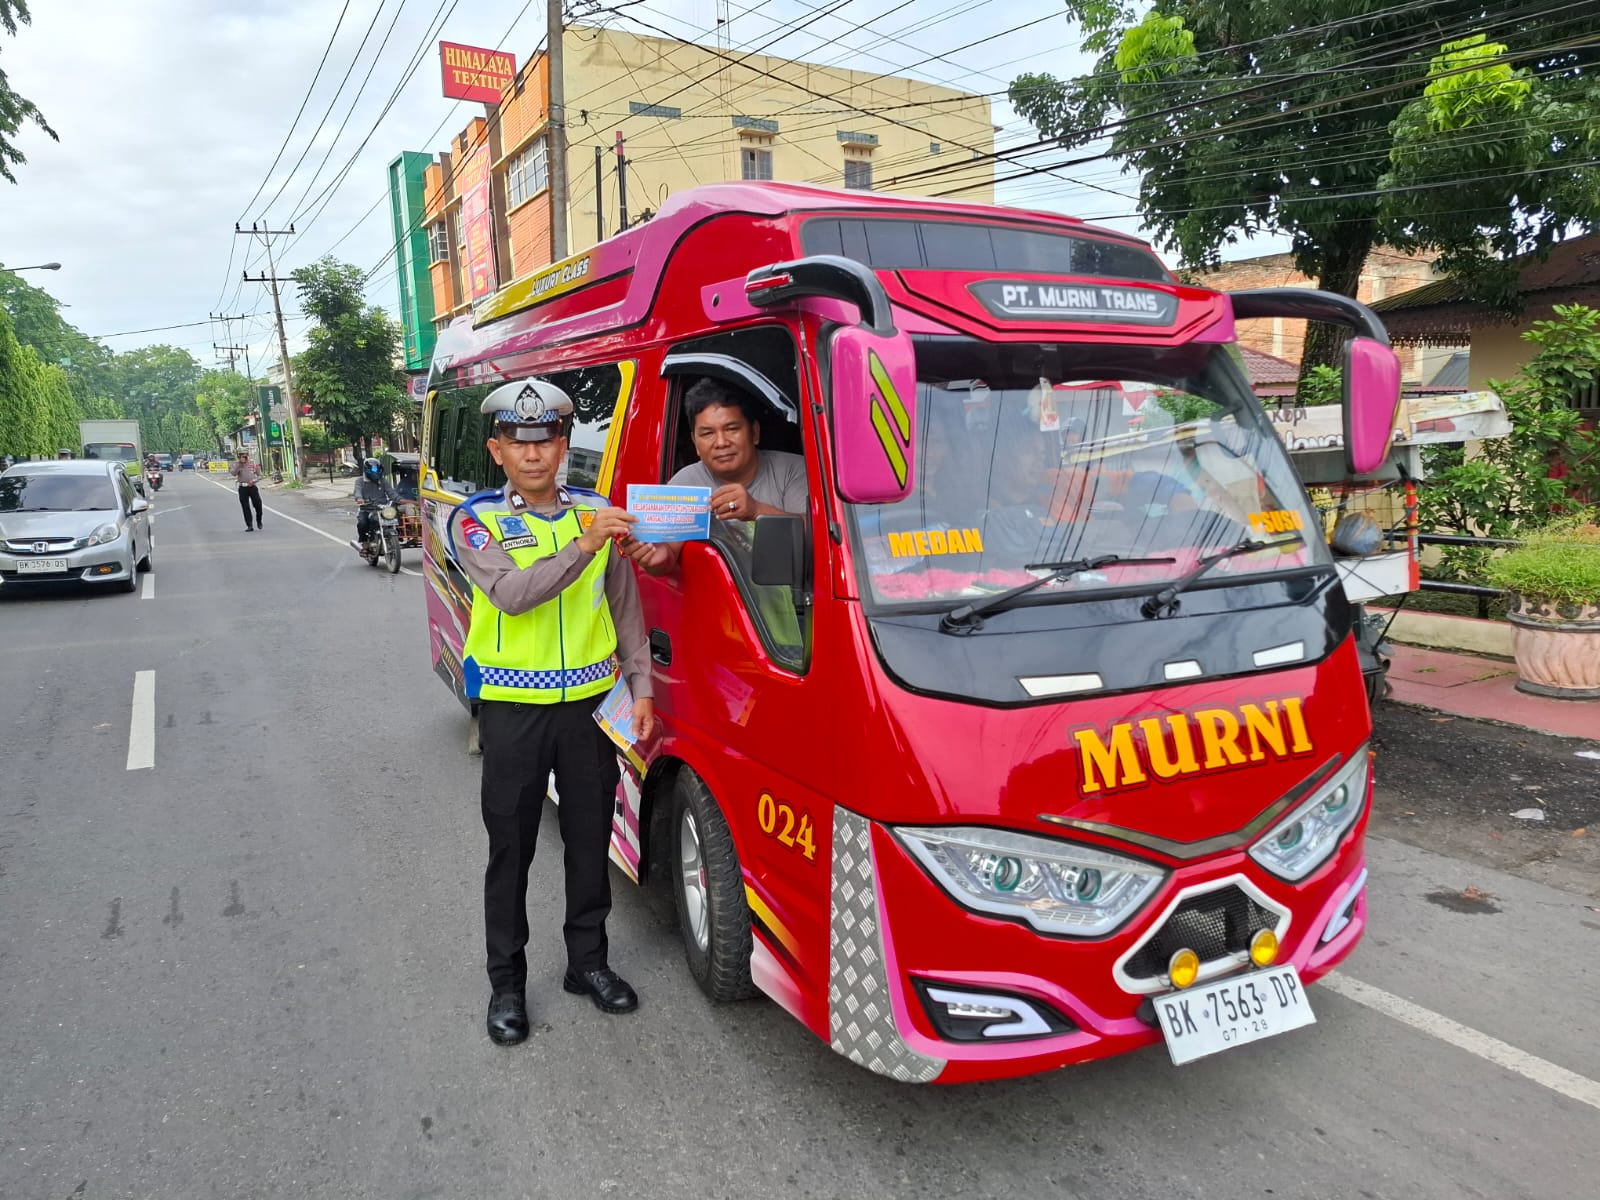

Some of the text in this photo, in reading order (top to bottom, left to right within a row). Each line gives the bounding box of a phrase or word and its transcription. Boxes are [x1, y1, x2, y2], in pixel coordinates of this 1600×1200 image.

[444, 46, 513, 76] HIMALAYA
[530, 255, 590, 297] LUXURY CLASS
[1002, 284, 1158, 312] PT. MURNI TRANS
[887, 527, 984, 558] MEDAN
[1074, 697, 1313, 793] MURNI
[758, 794, 816, 860] 024
[1164, 972, 1299, 1038] BK 7563 DP
